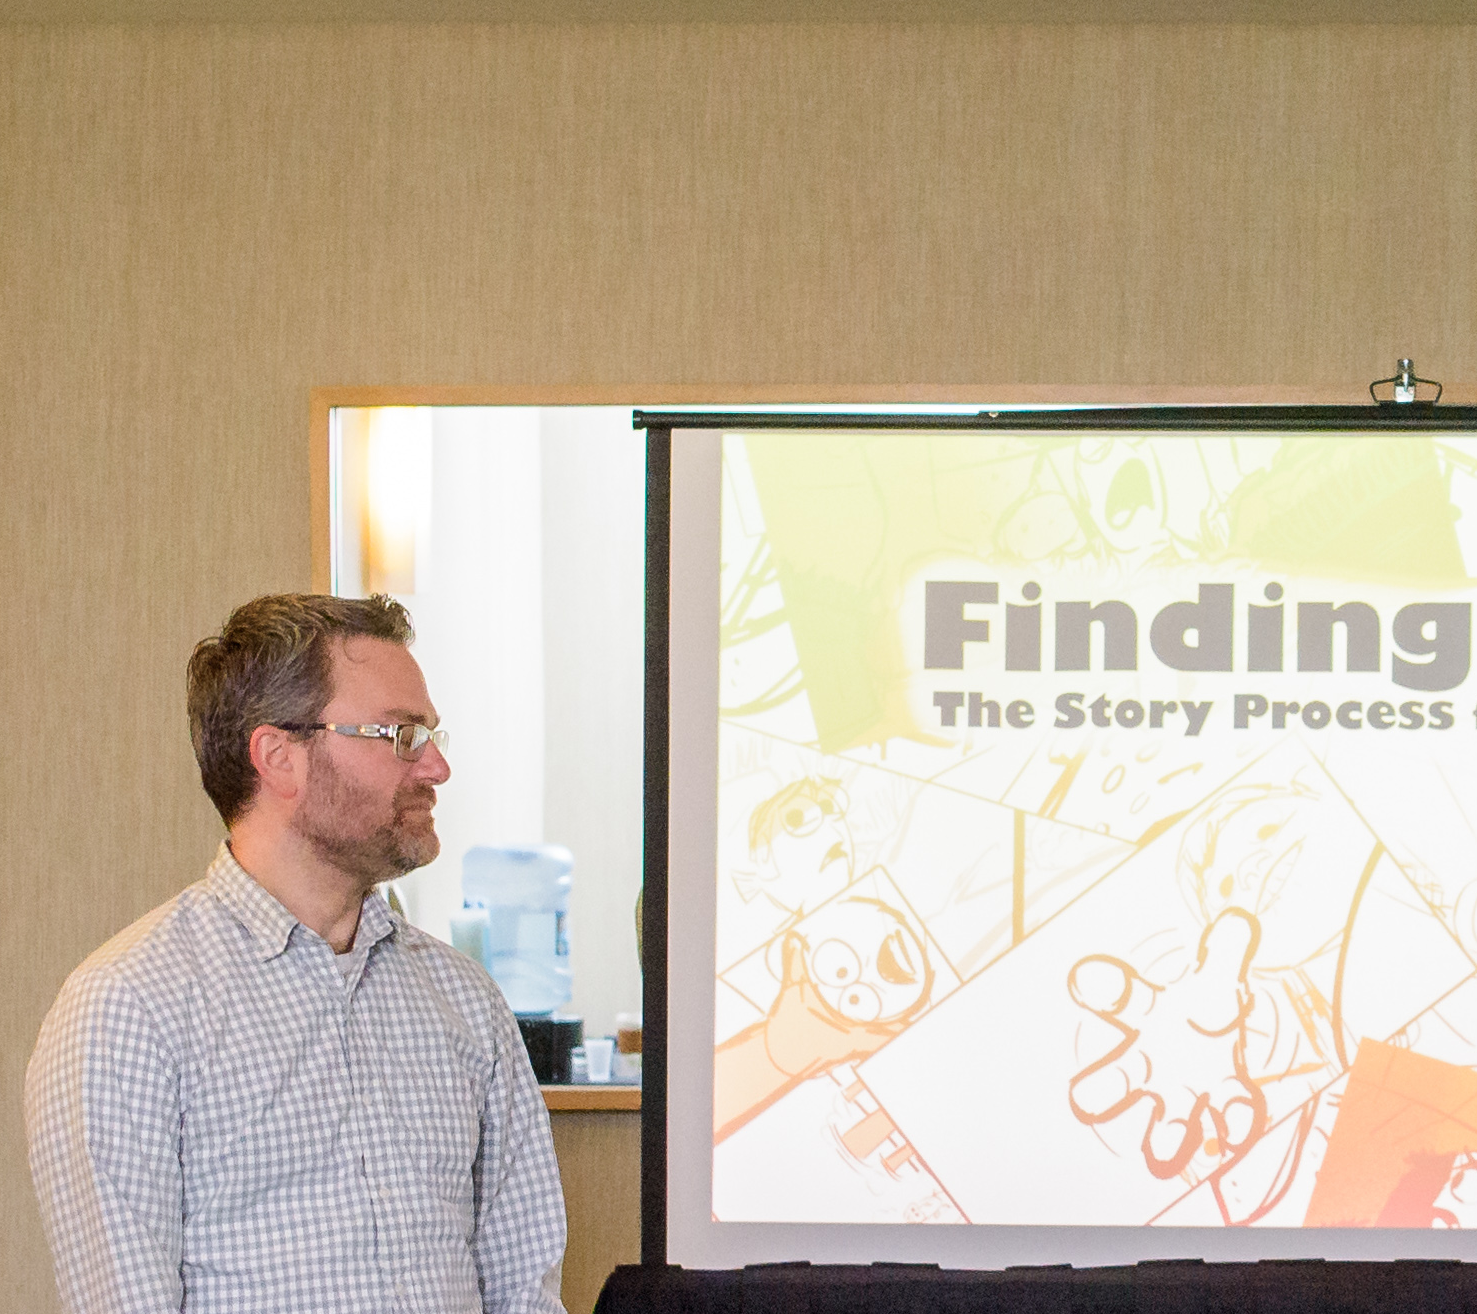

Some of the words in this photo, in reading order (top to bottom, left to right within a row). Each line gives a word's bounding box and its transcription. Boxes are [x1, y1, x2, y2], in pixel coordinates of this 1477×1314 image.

[924, 581, 1472, 692] Finding
[933, 692, 1035, 728] The
[1054, 693, 1211, 736] Story
[1234, 694, 1454, 730] Process
